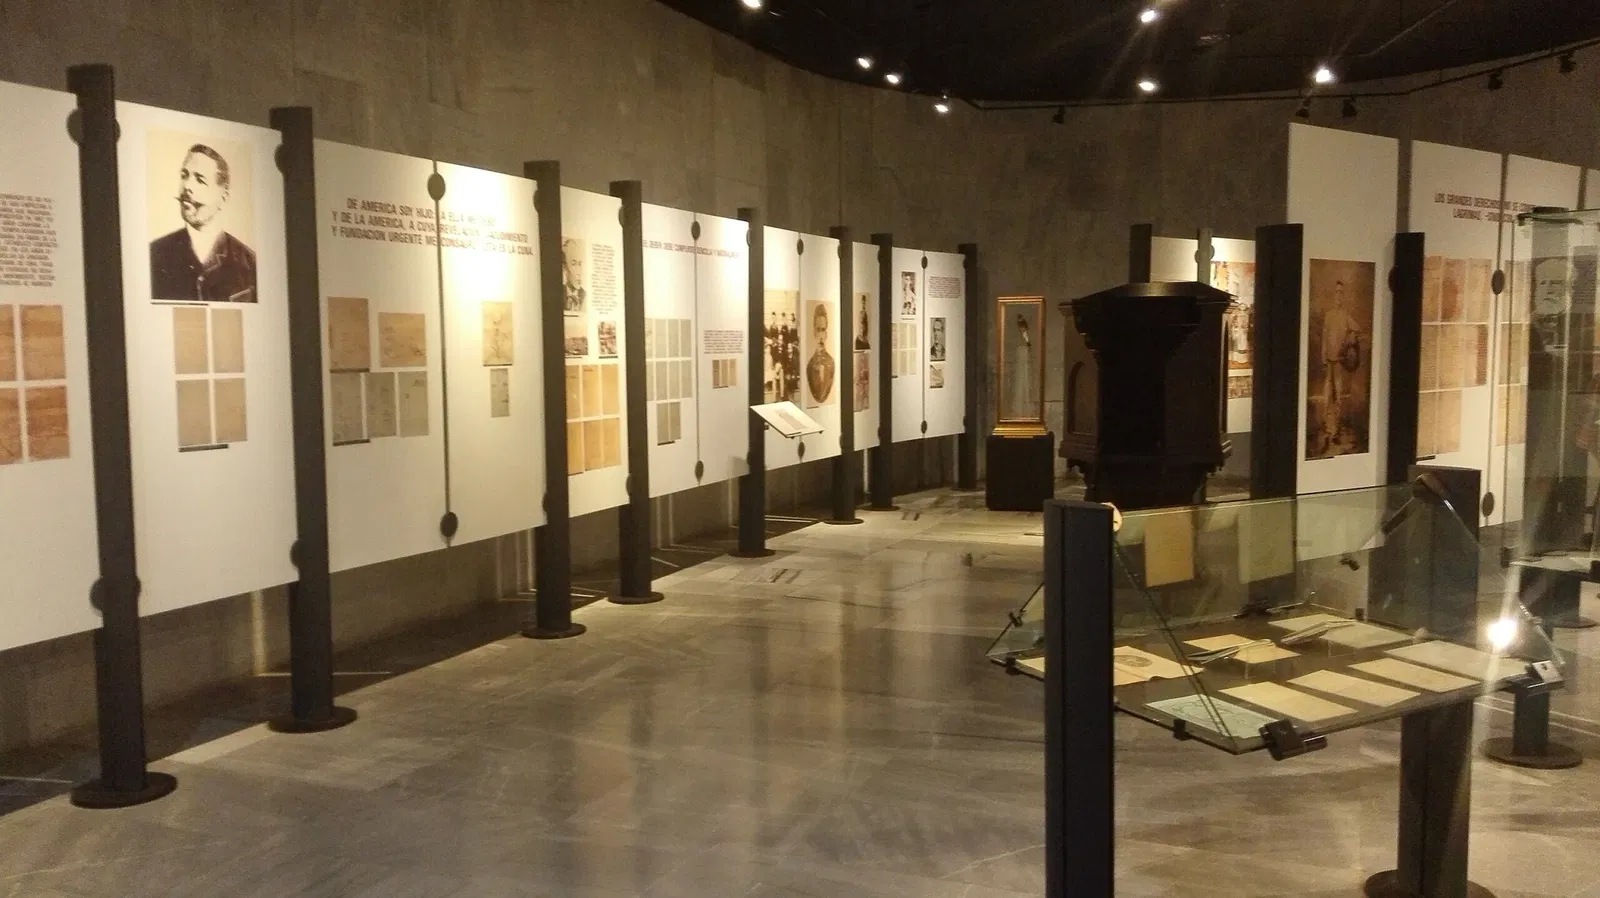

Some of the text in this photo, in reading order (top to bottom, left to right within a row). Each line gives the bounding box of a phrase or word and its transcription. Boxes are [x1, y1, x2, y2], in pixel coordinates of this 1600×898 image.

[346, 198, 357, 210] DE
[360, 200, 397, 214] AMERICA
[400, 205, 413, 216] SOY
[332, 211, 338, 222] Y
[340, 212, 352, 224] DE
[355, 213, 366, 226] LA
[409, 220, 415, 231] A
[417, 221, 436, 233] CUYA
[331, 225, 337, 237] Y
[340, 226, 386, 241] FUNDACION
[388, 232, 423, 245] URGENTE
[425, 235, 438, 247] ME
